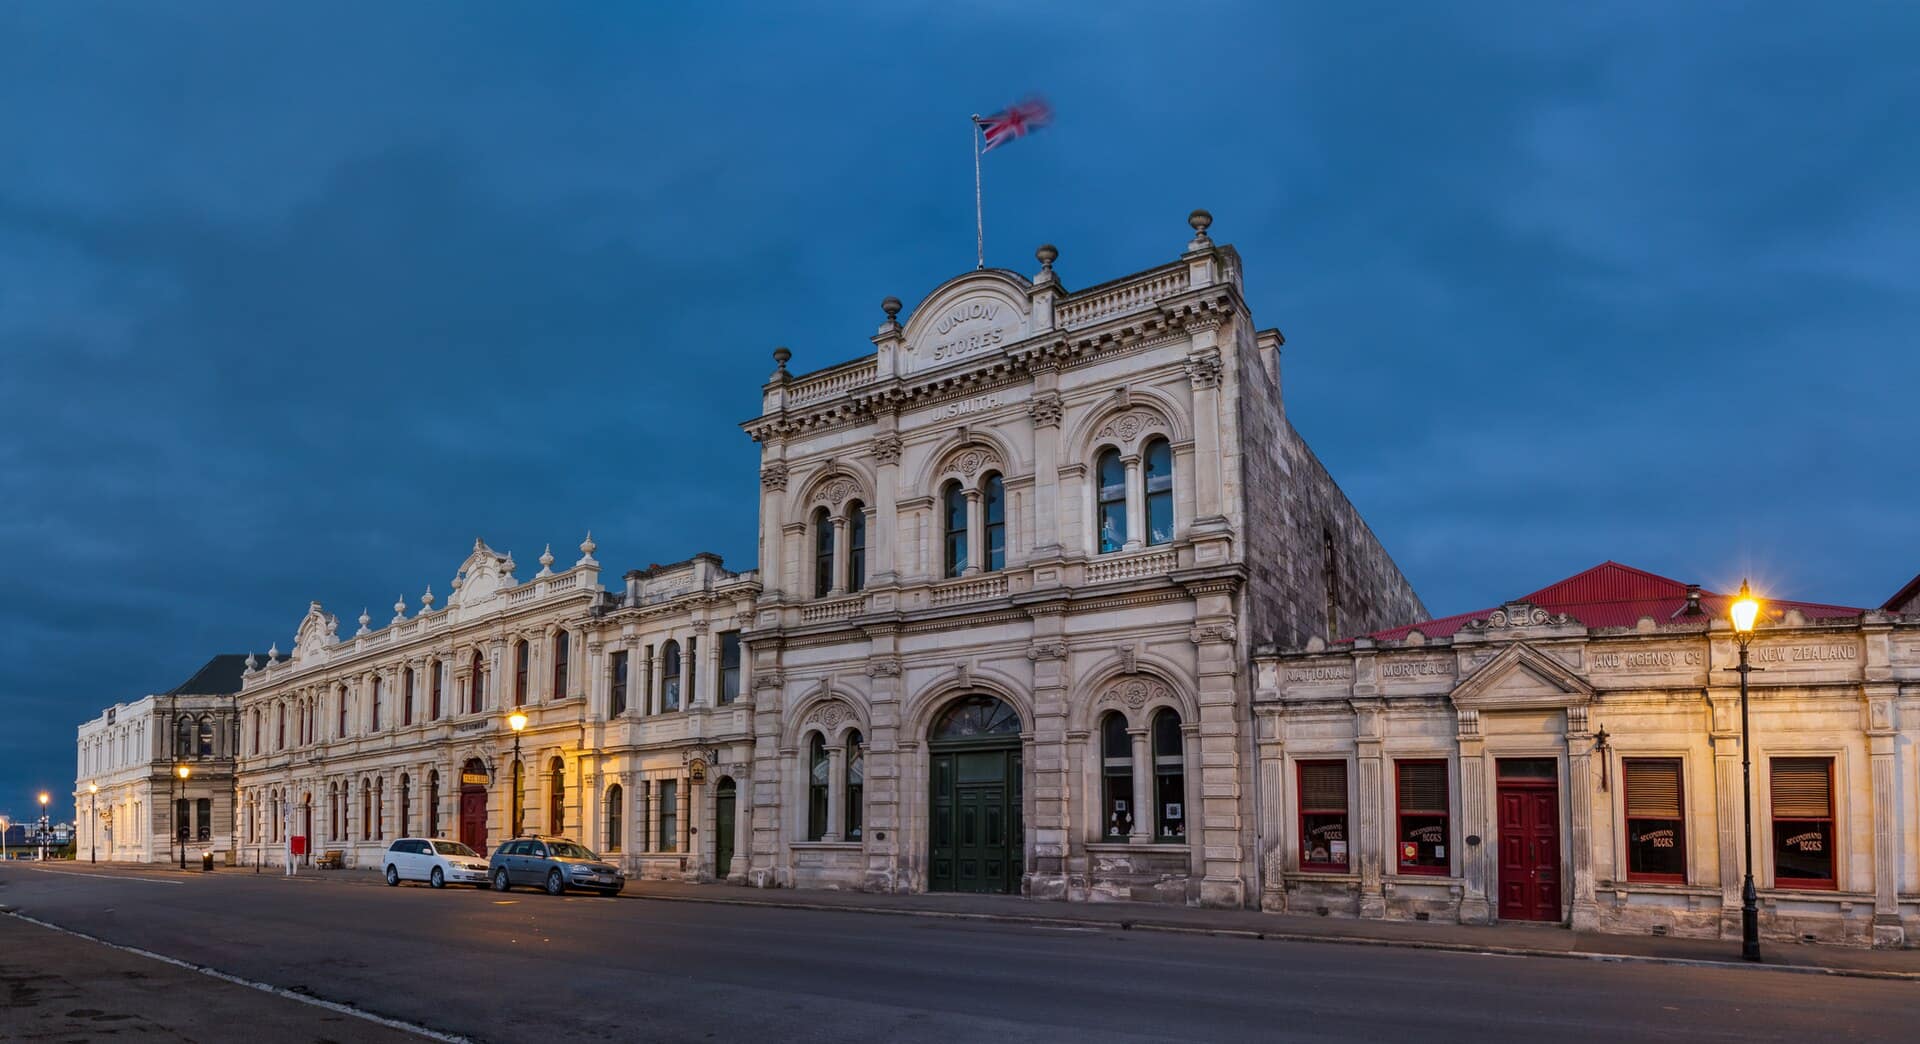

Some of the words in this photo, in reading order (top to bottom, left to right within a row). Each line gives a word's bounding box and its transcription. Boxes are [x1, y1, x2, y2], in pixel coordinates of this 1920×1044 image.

[938, 303, 1000, 335] UNION
[934, 328, 1004, 360] STORES
[1286, 665, 1351, 681] NATIONAL
[1594, 652, 1621, 668] AND
[1626, 650, 1677, 667] AGENCY
[1759, 646, 1786, 662] NEW
[1792, 645, 1857, 662] ZEALAND
[1653, 837, 1674, 848] BOOKS
[1800, 840, 1823, 851] BOOKS
